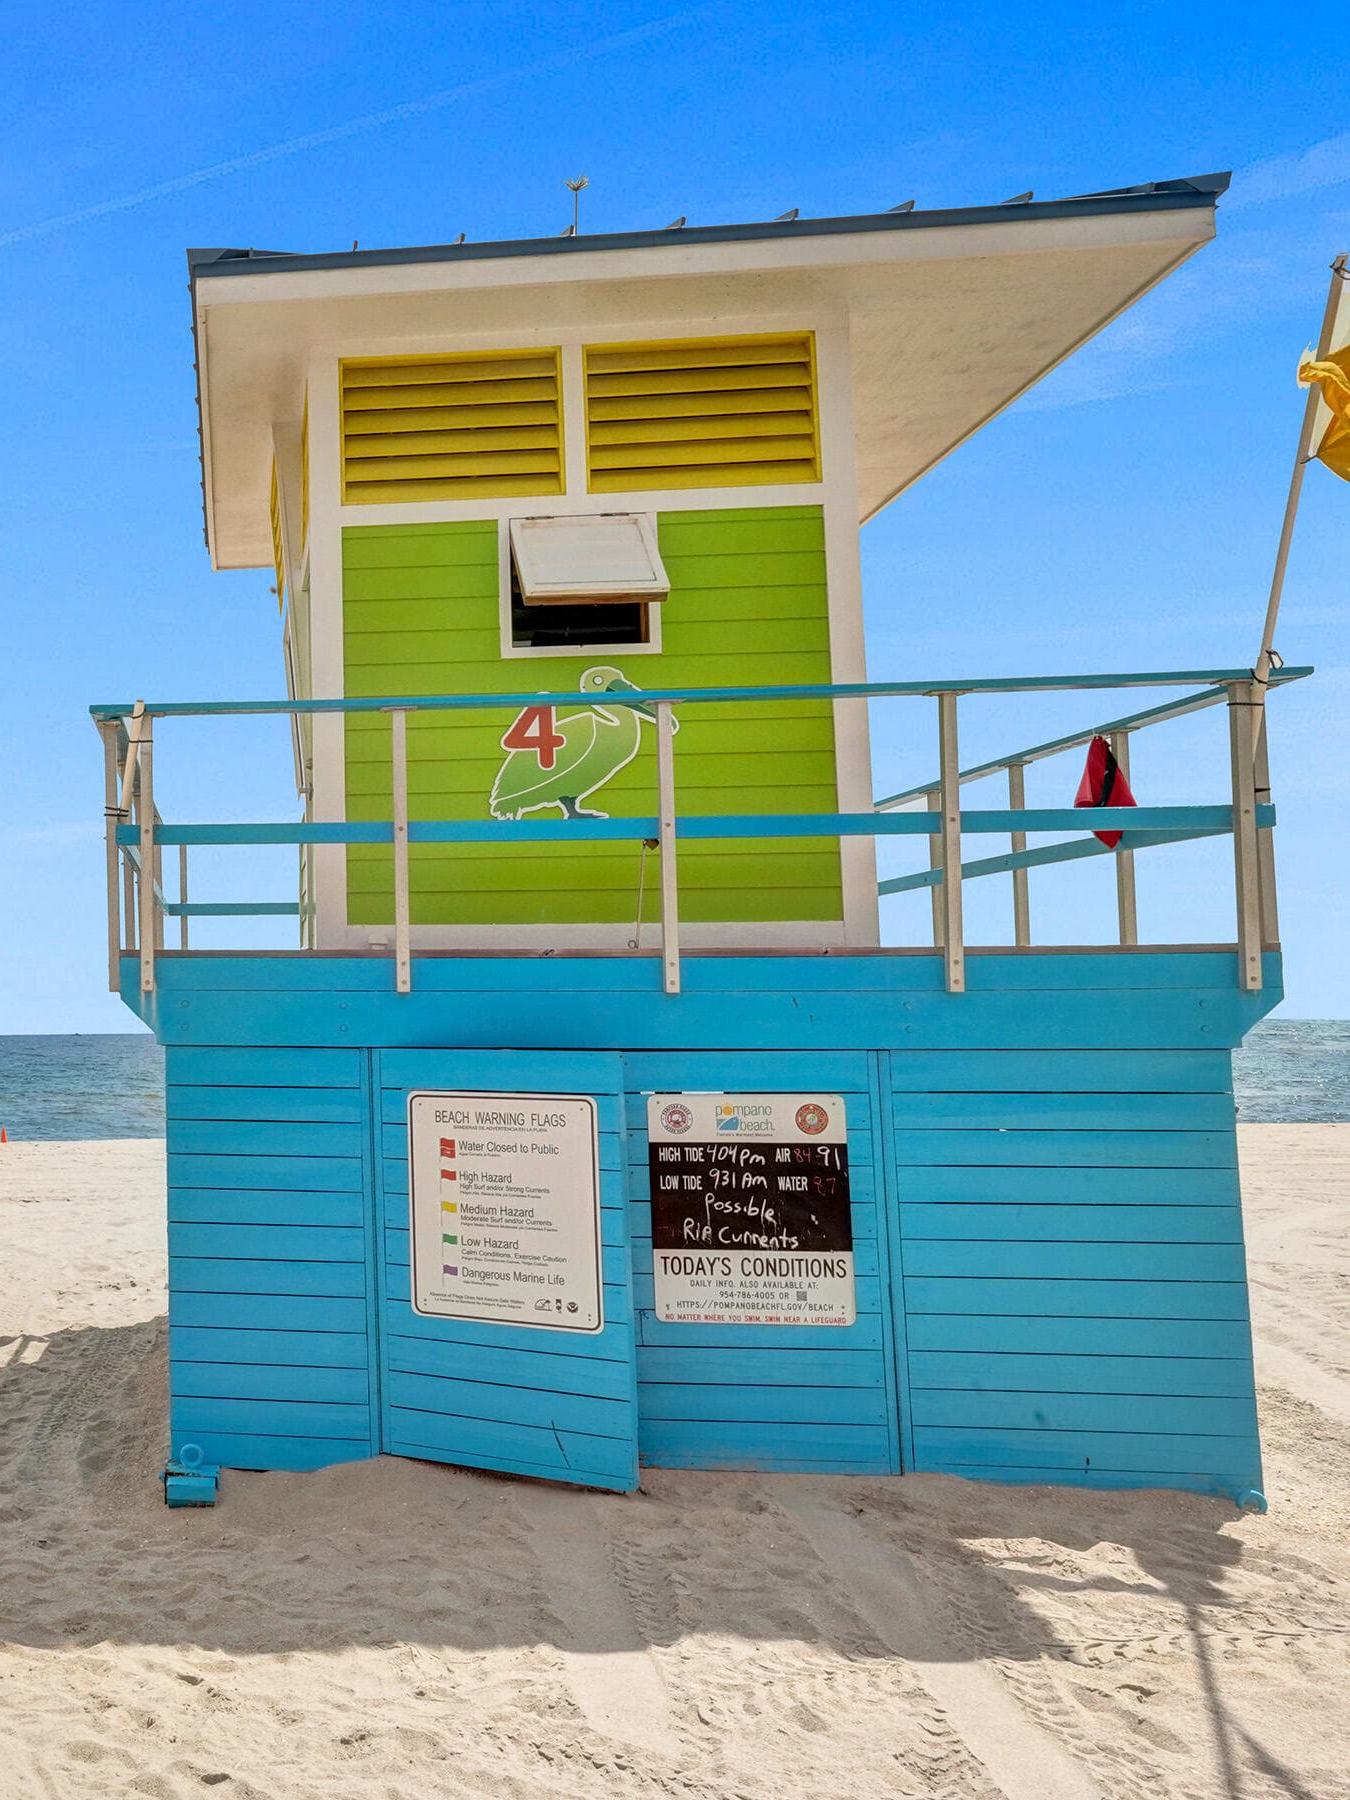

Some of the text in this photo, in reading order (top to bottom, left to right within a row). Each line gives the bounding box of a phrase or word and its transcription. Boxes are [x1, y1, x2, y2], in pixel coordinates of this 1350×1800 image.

[502, 693, 566, 770] 4
[435, 1110, 566, 1128] BEACH WARNING FLAGS
[458, 1140, 559, 1155] Water Closed to Public
[658, 1146, 705, 1162] HIGH TIDE
[775, 1147, 791, 1163] AIR
[459, 1171, 512, 1184] High Hazard
[659, 1175, 703, 1190] LOW TIDE
[777, 1176, 808, 1191] WATER
[505, 1185, 524, 1194] Strong
[525, 1186, 550, 1194] Currents
[460, 1203, 534, 1218] Medium Hazard
[460, 1215, 489, 1223] Moderate
[525, 1219, 552, 1227] Currents
[461, 1235, 519, 1249] Low Hazard
[542, 1255, 567, 1263] Caution
[660, 1256, 847, 1278] TODAY'S CONDITIONS
[461, 1266, 511, 1281] Dangerous
[513, 1271, 545, 1284] Marine
[547, 1273, 565, 1286] Life
[689, 1279, 712, 1288] DAILY
[739, 1280, 759, 1289] ALSO
[762, 1281, 803, 1289] AVAILABLE
[719, 1290, 790, 1300] 954-786-4005 OR
[665, 1313, 674, 1321] NO
[677, 1313, 701, 1321] MATTER
[729, 1314, 742, 1322] YOU
[765, 1315, 780, 1323] SWIM
[811, 1316, 847, 1324] LIFEGUARD
